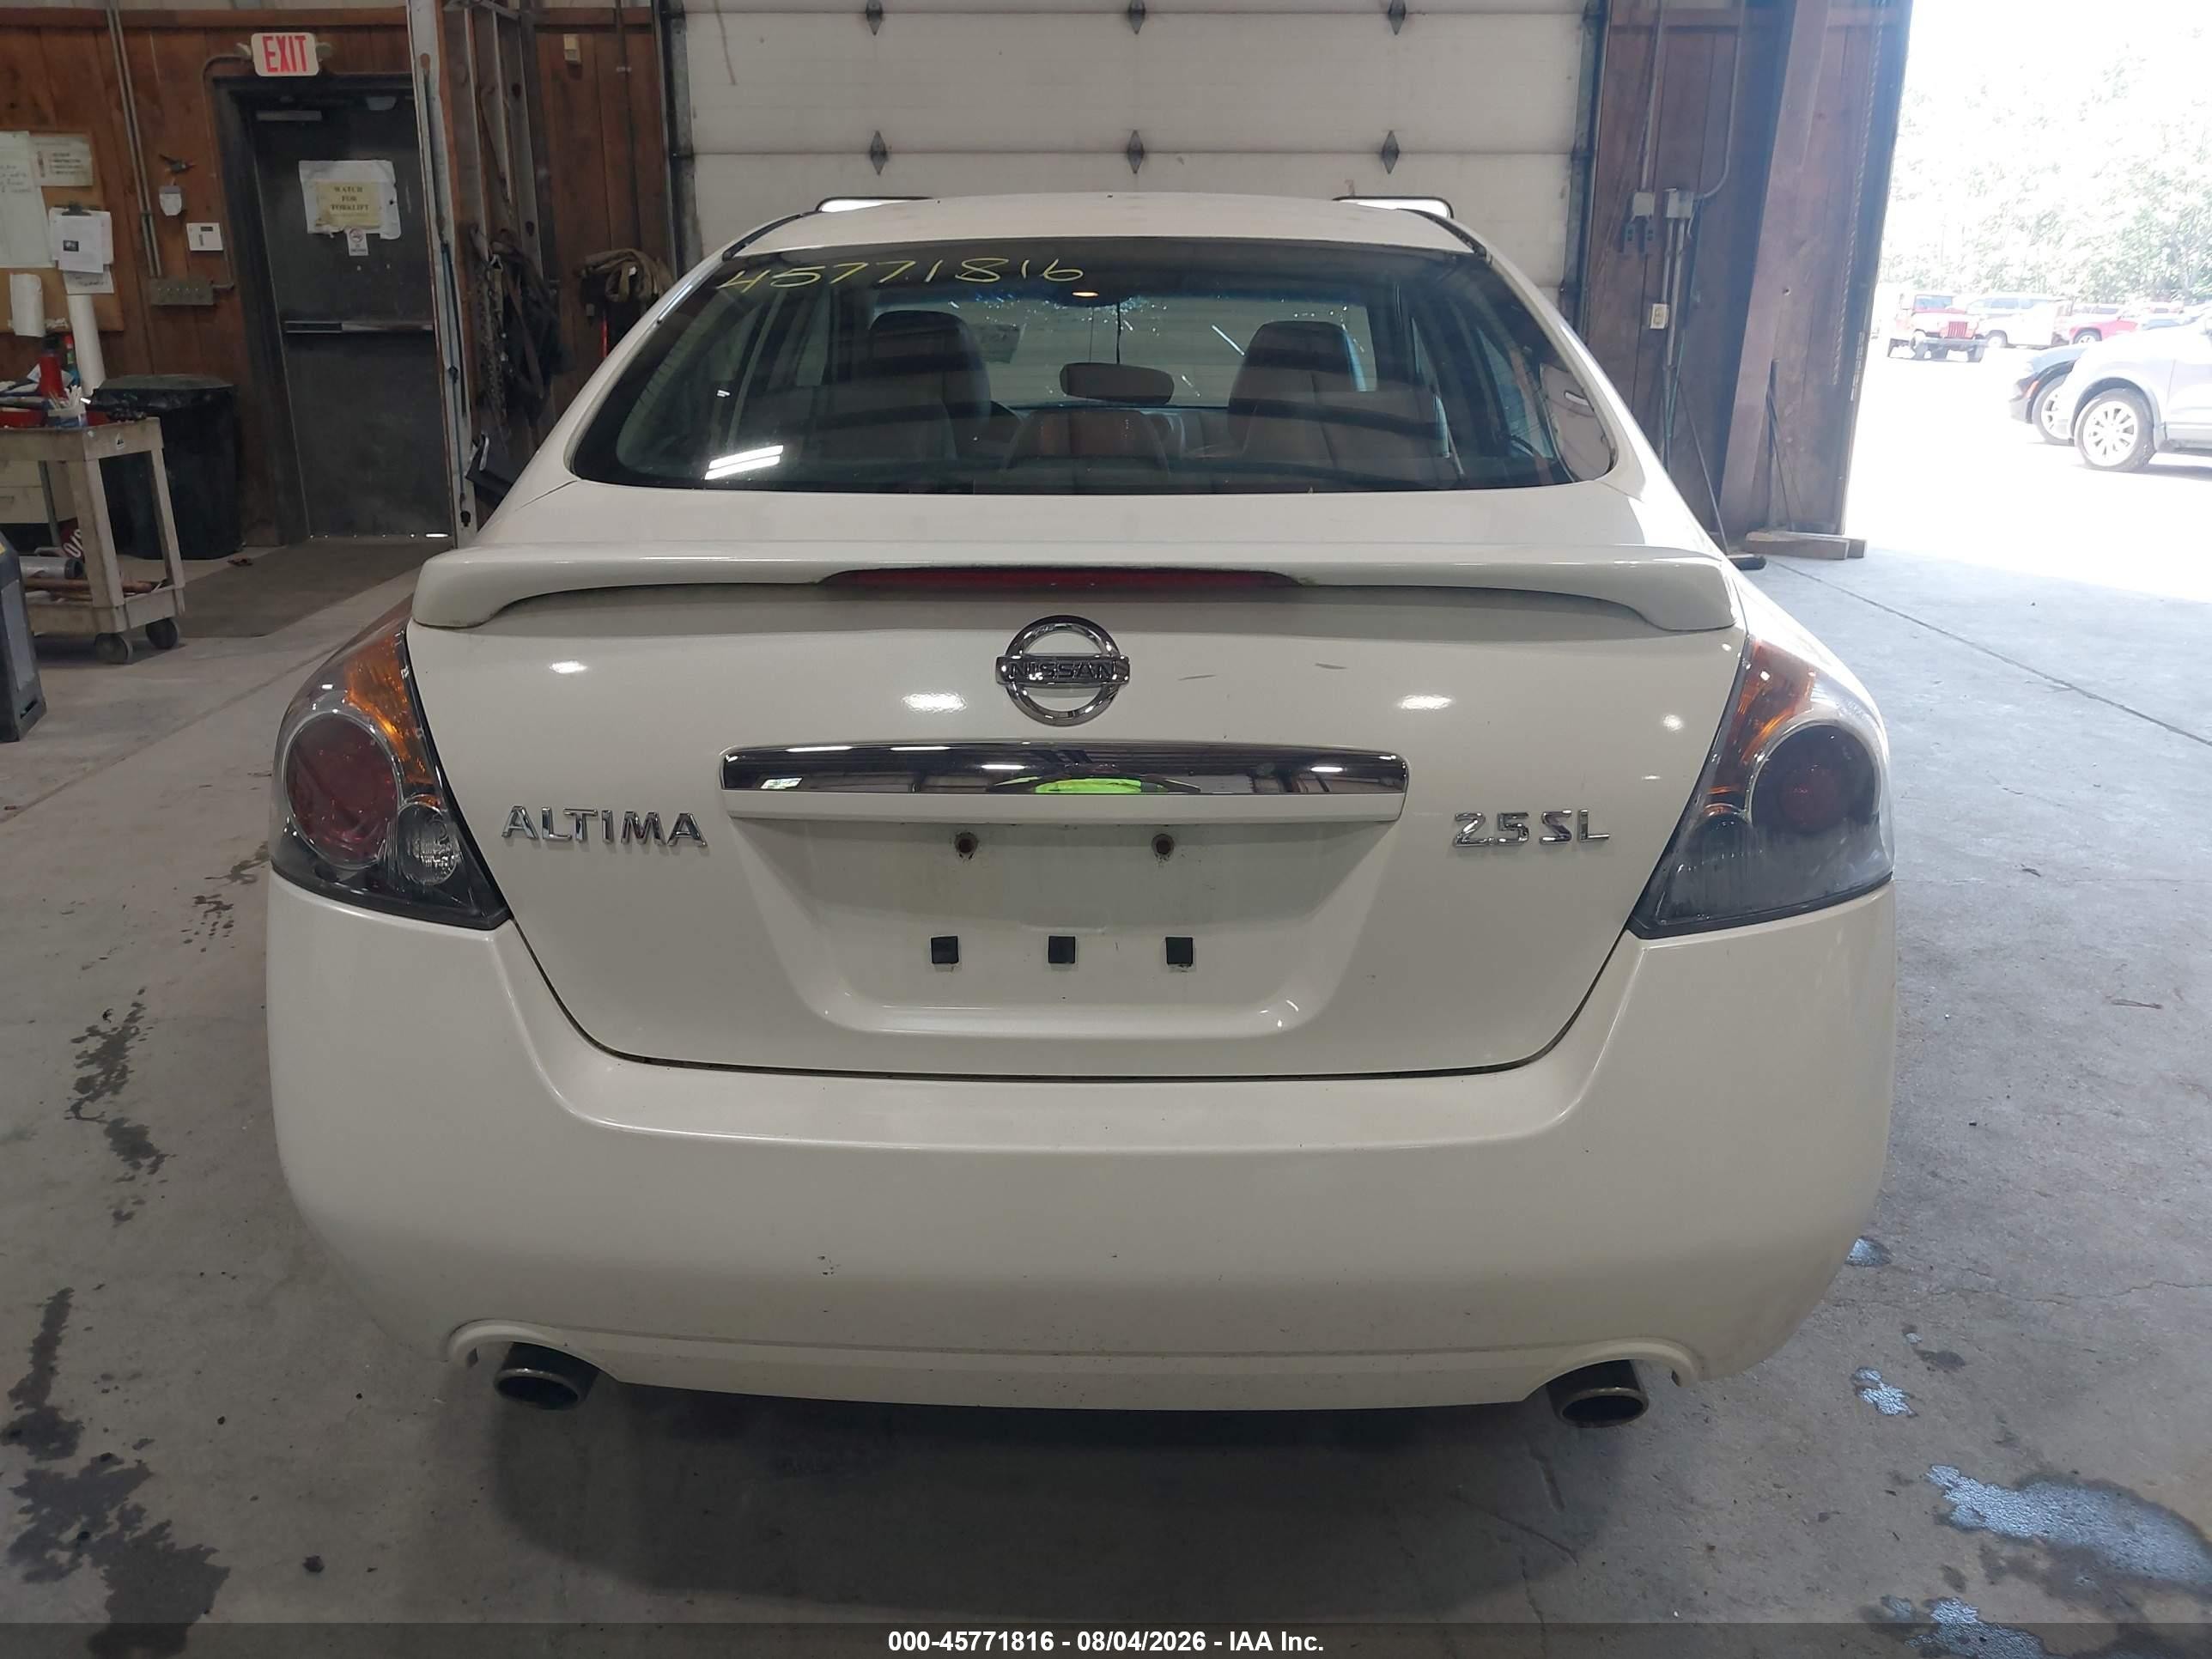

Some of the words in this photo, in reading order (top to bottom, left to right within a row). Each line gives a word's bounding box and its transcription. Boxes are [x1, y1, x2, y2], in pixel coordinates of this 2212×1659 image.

[262, 35, 307, 72] EXIT
[716, 258, 1084, 293] 45771816
[1009, 660, 1117, 681] NISSAN
[501, 805, 708, 848] ALTIMA
[1453, 812, 1529, 847] 2.5
[1540, 810, 1610, 845] SL
